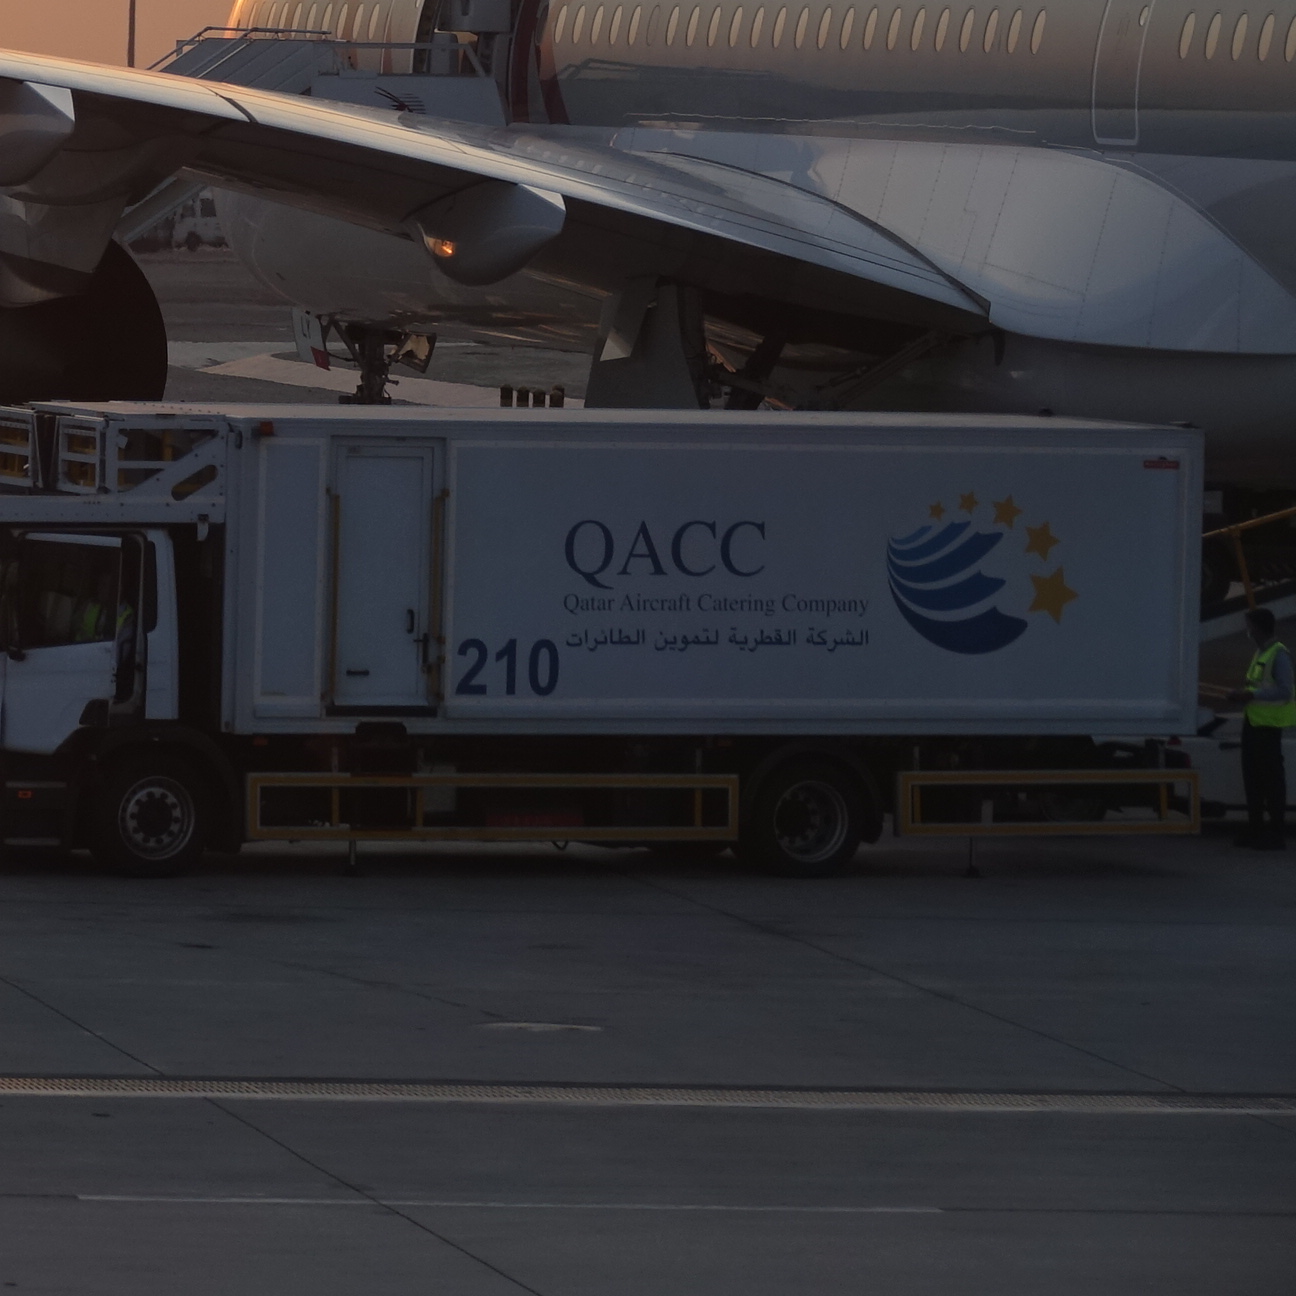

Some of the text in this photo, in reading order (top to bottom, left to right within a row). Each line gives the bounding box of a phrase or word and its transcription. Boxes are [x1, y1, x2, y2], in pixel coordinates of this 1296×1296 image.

[564, 519, 766, 590] QACC
[563, 593, 869, 617] Qatar Aircraft Catering Company
[565, 626, 869, 652] الشركة القطرية لتموين الطائرات
[455, 638, 560, 697] 210
